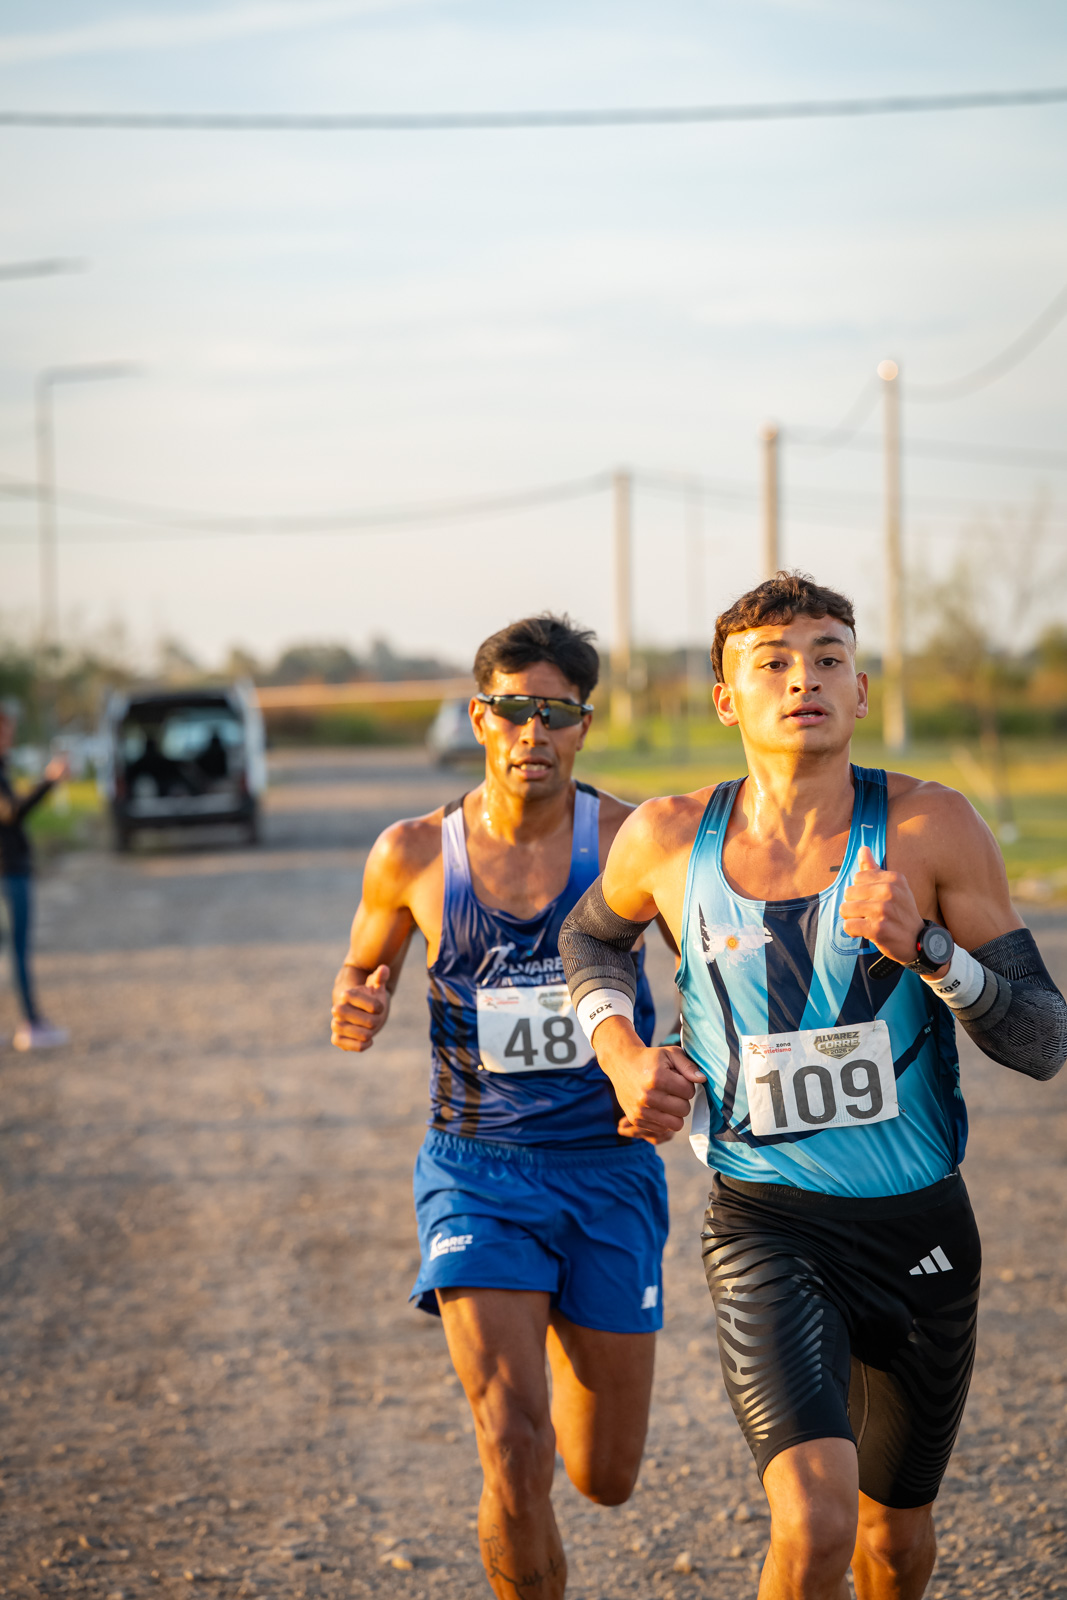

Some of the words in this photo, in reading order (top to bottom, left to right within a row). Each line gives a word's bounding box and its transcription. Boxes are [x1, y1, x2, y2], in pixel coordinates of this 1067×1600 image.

[937, 979, 961, 993] SOX
[589, 1003, 613, 1020] SOX
[504, 1016, 577, 1066] 48
[814, 1031, 860, 1044] ALVAREZ
[817, 1038, 861, 1050] CORRE
[755, 1059, 883, 1129] 109
